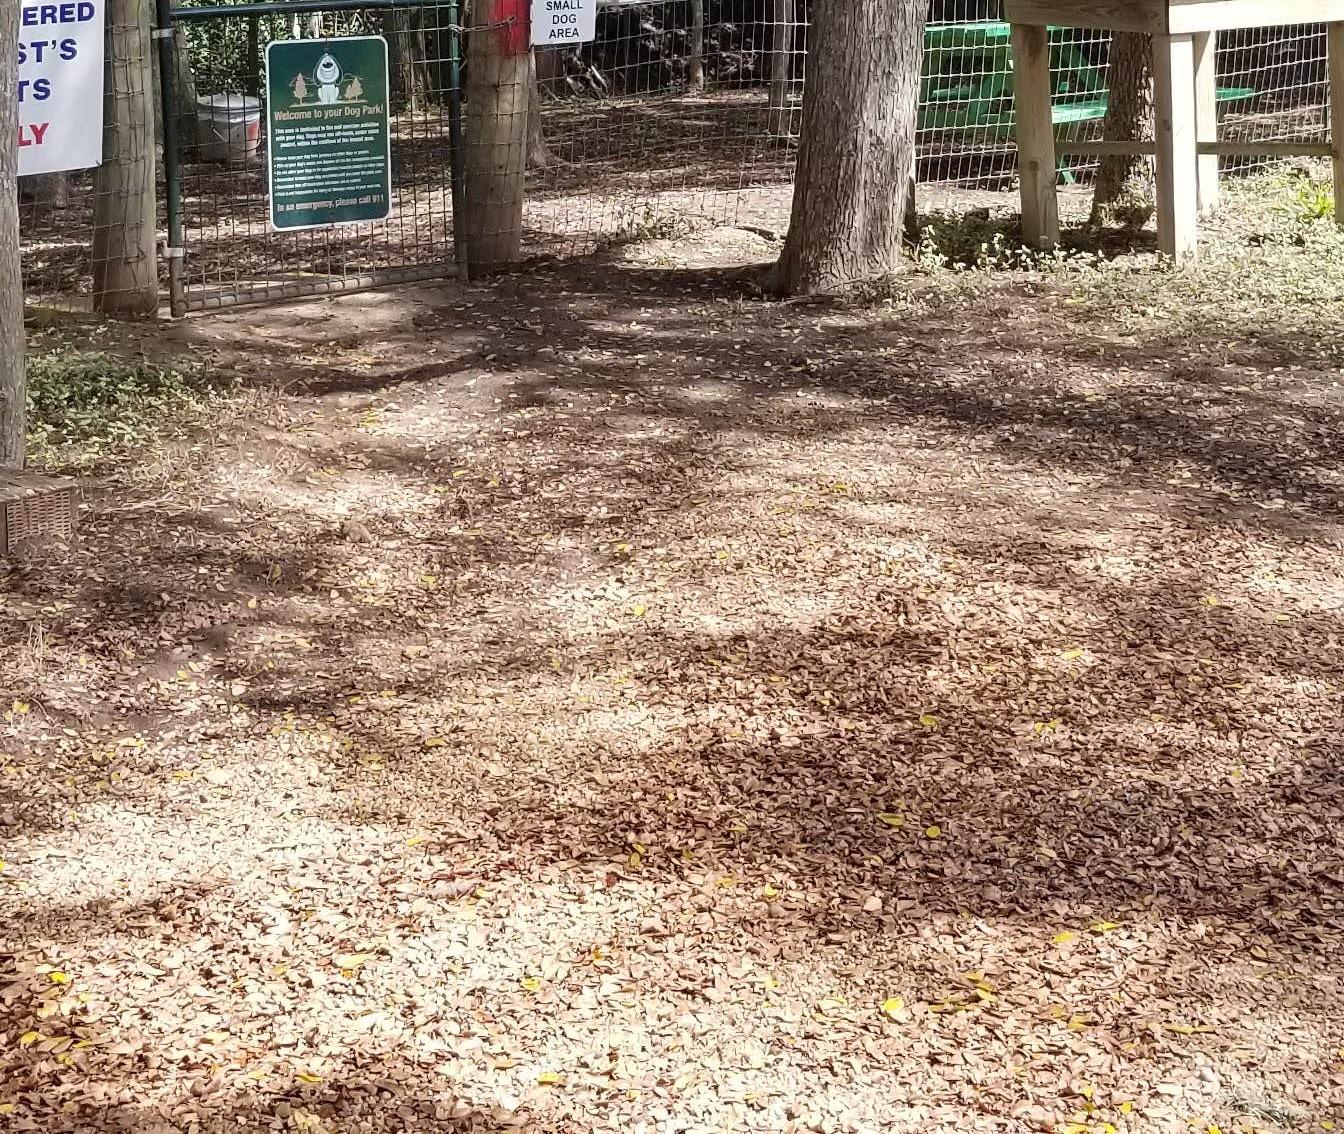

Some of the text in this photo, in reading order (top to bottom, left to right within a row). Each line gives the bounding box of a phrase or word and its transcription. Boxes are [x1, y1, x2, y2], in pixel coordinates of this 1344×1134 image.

[546, 0, 584, 11] SMALL
[552, 14, 577, 25] DOG
[548, 28, 580, 39] AREA
[17, 78, 52, 103] TS
[274, 104, 384, 121] Welcome to your Dog Park!
[18, 122, 50, 147] LY
[335, 197, 357, 207] please
[358, 194, 371, 204] call
